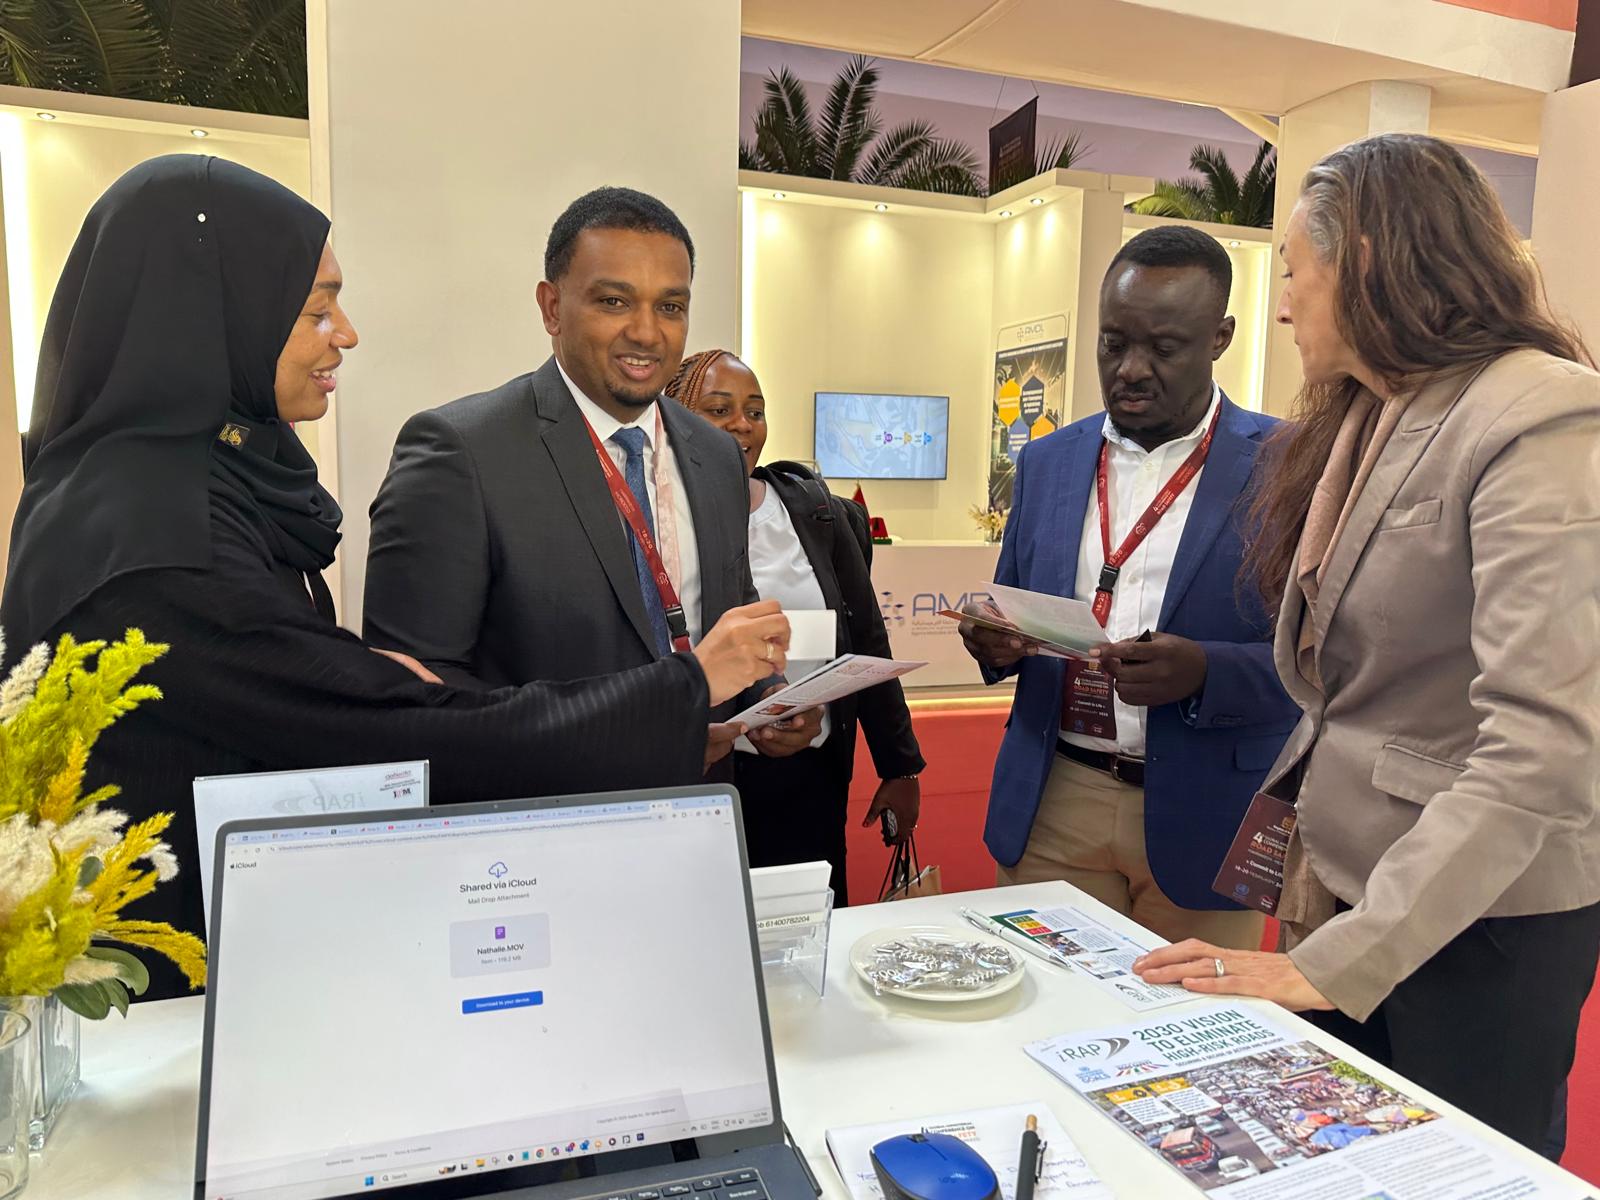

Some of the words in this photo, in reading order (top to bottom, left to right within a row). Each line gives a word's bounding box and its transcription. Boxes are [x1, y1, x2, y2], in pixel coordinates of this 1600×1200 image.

[235, 861, 257, 869] iCloud
[460, 881, 492, 893] Shared
[494, 880, 506, 889] via
[508, 878, 537, 888] iCloud
[477, 943, 524, 955] Nathalie.MOV
[1132, 1023, 1184, 1041] 2030
[1182, 1008, 1245, 1031] VISION
[1146, 1038, 1175, 1053] TO
[1174, 1019, 1263, 1046] ELIMINATE
[1162, 1040, 1236, 1062] HIGH-RISK
[1231, 1028, 1276, 1045] ROADS
[1056, 1043, 1102, 1063] iRAP
